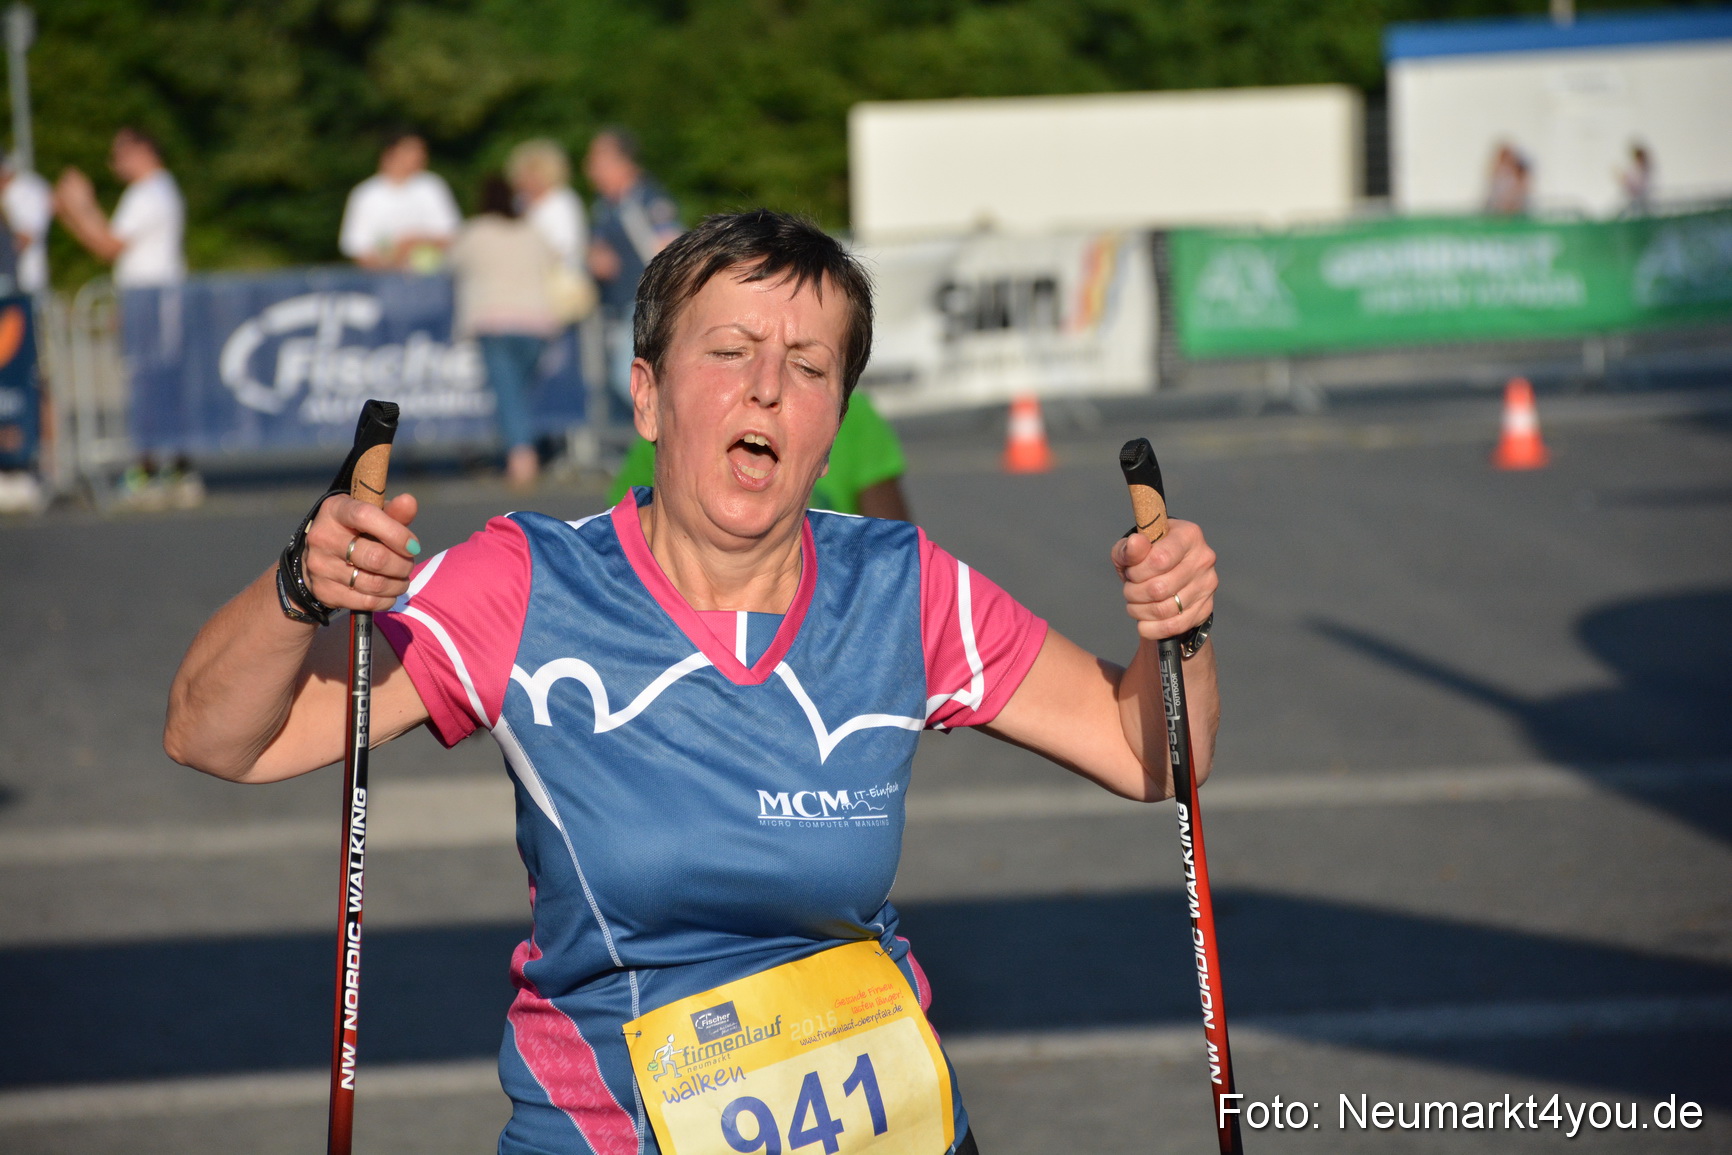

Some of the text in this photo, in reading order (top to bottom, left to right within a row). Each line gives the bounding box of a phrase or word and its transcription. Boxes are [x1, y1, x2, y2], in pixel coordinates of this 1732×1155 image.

[1171, 672, 1181, 706] OUTDOOR
[757, 789, 849, 818] MCM
[759, 818, 890, 829] MICRO COMPUTER MANAGING
[340, 787, 367, 1090] NW NORDIC WALKING
[1176, 802, 1222, 1085] NW NORDIC WALKING
[702, 1013, 730, 1027] Fischer
[682, 1014, 781, 1066] firmenlauf
[687, 1053, 732, 1073] neumarkt
[662, 1066, 746, 1104] walken
[720, 1053, 888, 1155] 941
